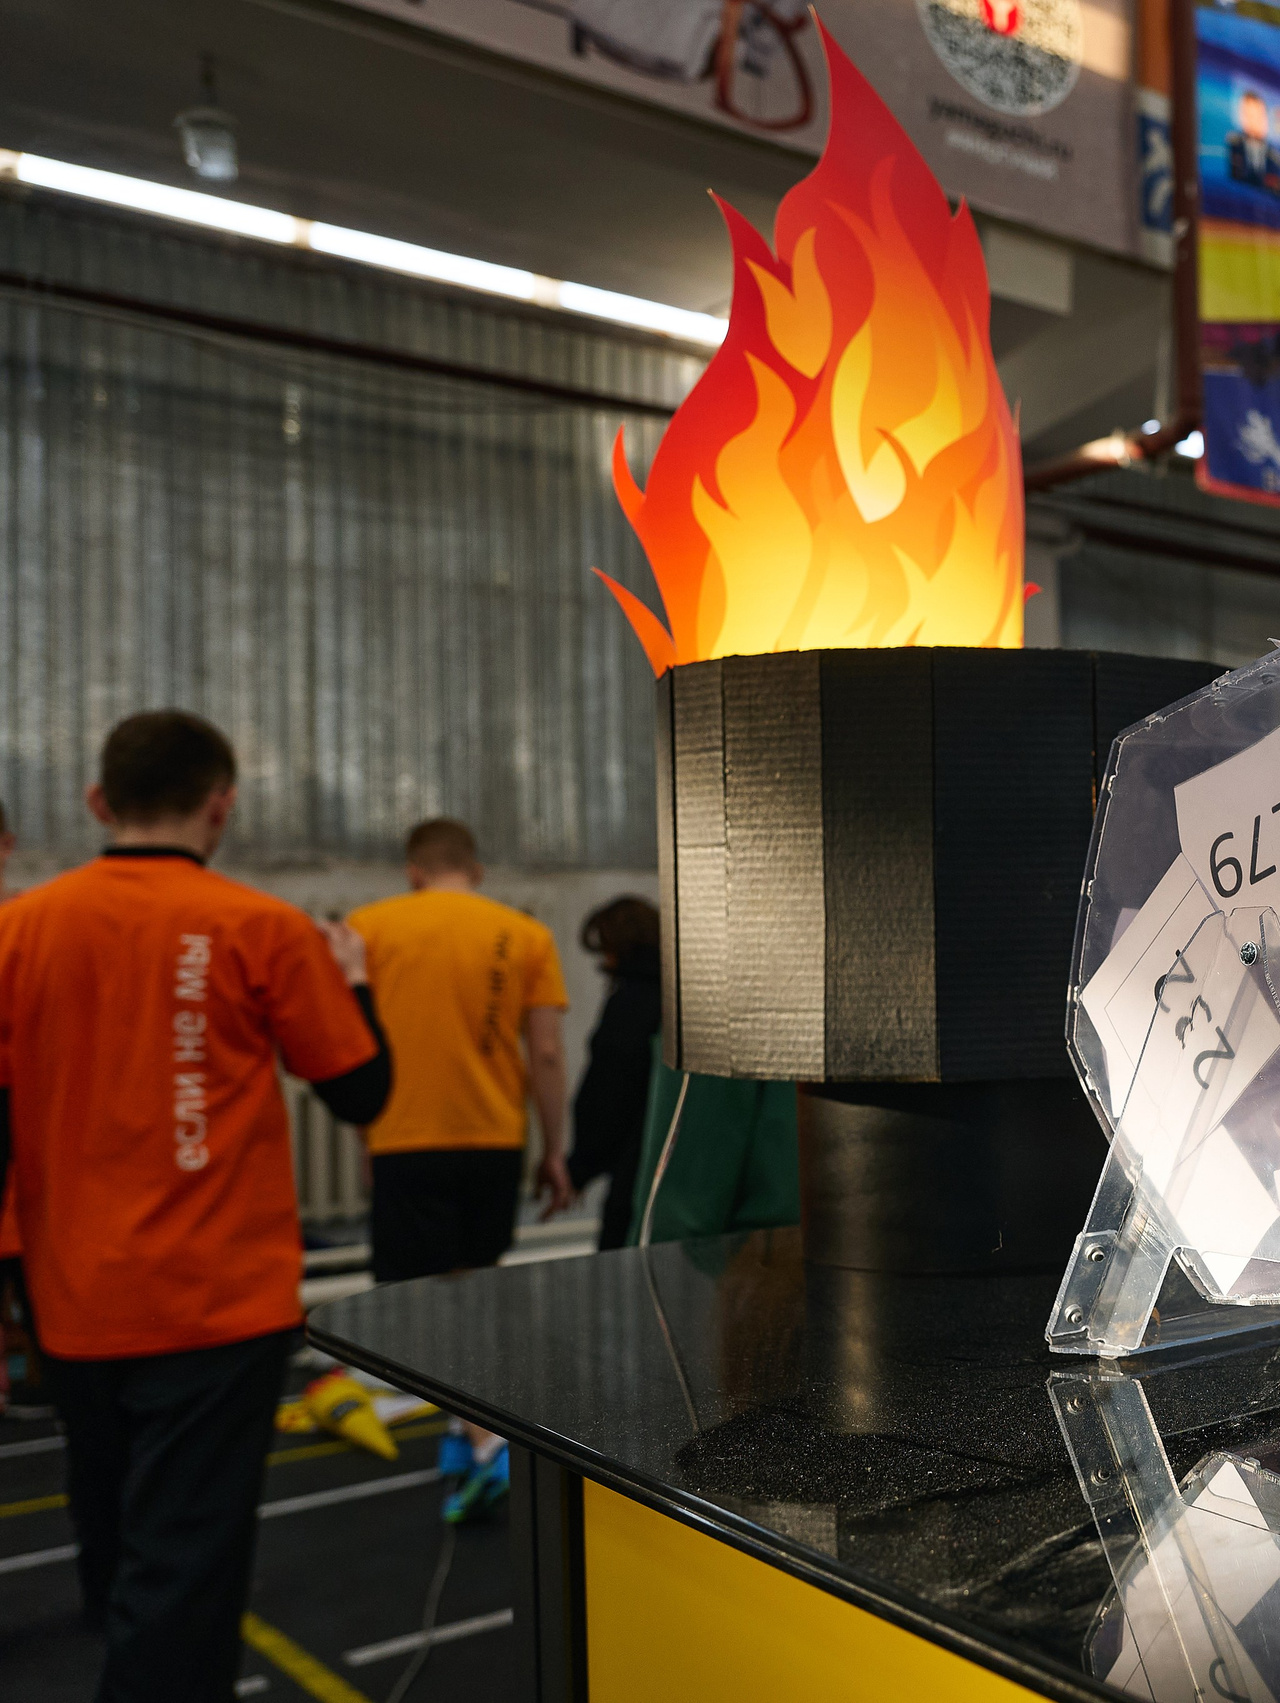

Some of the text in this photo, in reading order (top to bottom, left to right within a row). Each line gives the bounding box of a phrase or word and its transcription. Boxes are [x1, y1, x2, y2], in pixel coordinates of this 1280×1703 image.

[172, 933, 212, 1172] если не мы
[1154, 949, 1236, 1090] 232
